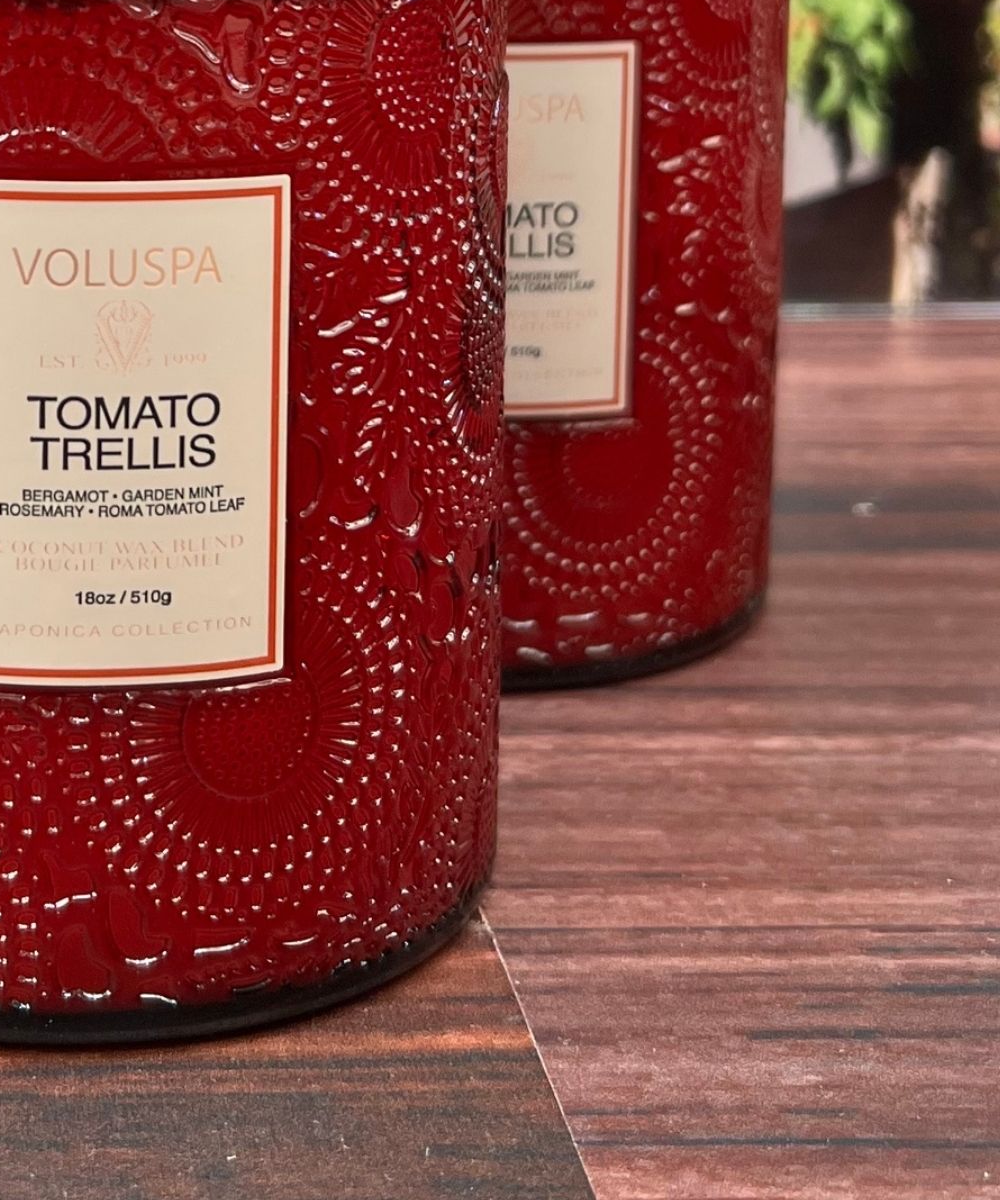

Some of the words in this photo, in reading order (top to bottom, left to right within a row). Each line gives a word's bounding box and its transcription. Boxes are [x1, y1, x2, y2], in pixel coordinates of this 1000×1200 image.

[509, 231, 575, 258] LLIS
[12, 246, 223, 287] VOLUSPA
[27, 392, 220, 430] TOMATO
[30, 433, 216, 471] TRELLIS
[21, 488, 109, 503] BERGAMOT
[122, 487, 185, 502] GARDEN
[188, 485, 224, 500] MINT
[98, 505, 143, 518] ROMA
[146, 501, 207, 517] TOMATO
[209, 498, 246, 513] LEAF
[114, 539, 164, 555] WAX
[173, 534, 244, 554] BLEND
[15, 556, 95, 572] BOUGIE
[75, 590, 116, 606] 18oz
[130, 589, 172, 607] 510g
[111, 615, 253, 638] COLLECTION
